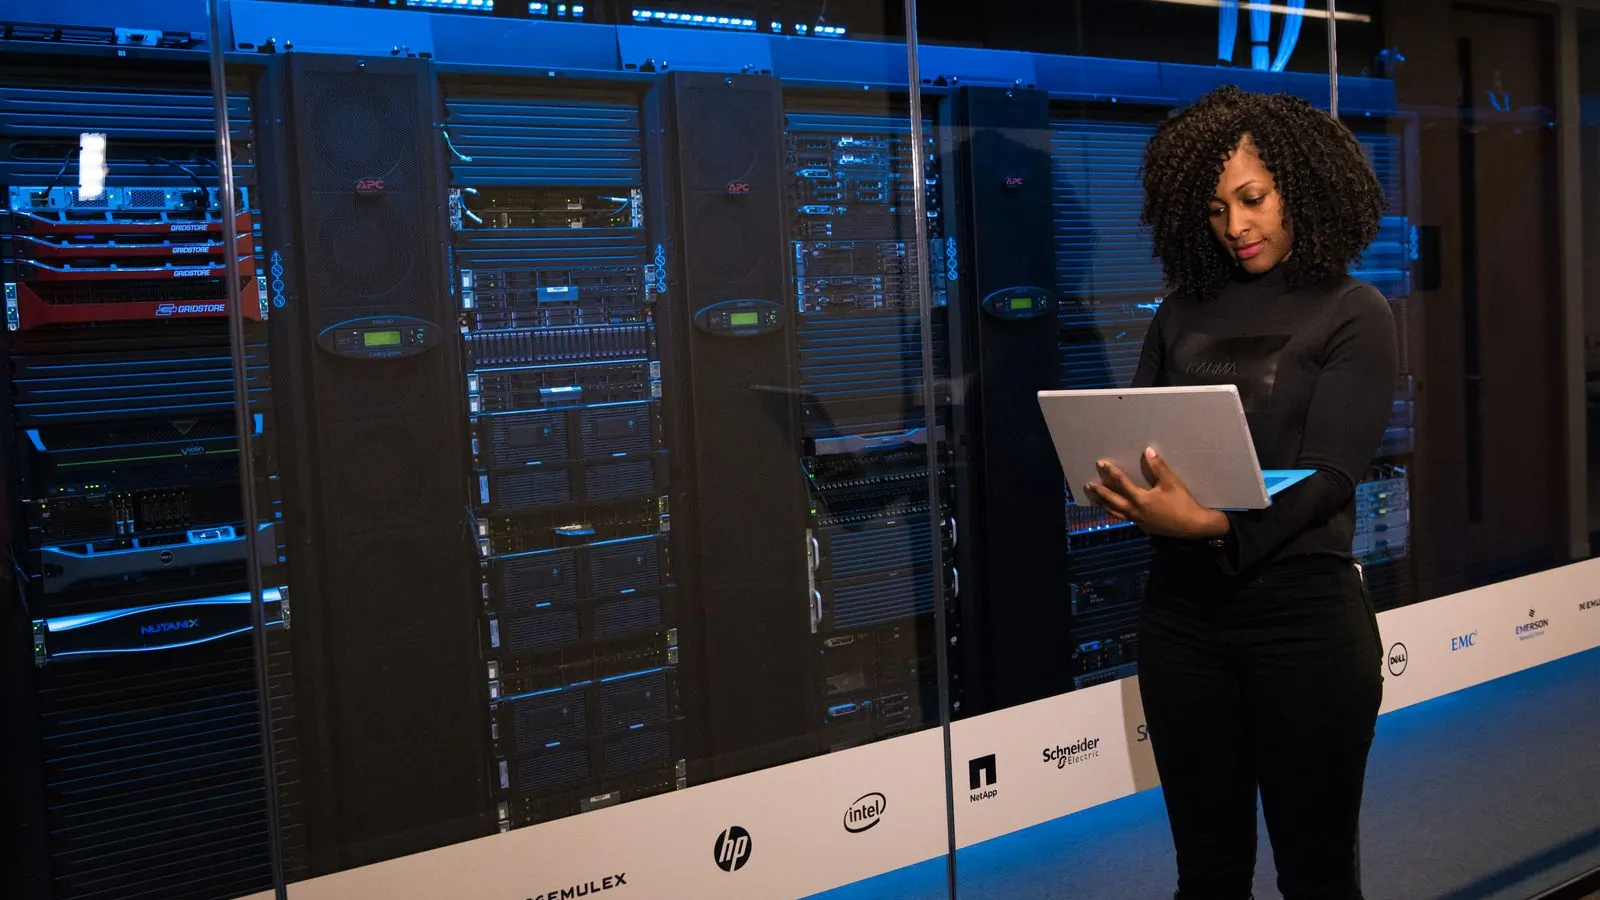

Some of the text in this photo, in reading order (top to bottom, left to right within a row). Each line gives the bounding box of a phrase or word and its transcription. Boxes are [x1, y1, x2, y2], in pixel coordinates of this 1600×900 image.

[356, 179, 385, 190] APC
[170, 224, 208, 232] GRIDSTORE
[172, 246, 210, 254] GRIDSTORE
[173, 269, 211, 277] GRIDSTORE
[178, 303, 225, 313] GRIDSTORE
[141, 618, 200, 636] NUTANIX
[1515, 618, 1549, 635] EMERSON
[1390, 653, 1406, 665] DELL
[1042, 737, 1100, 762] Schneider
[1067, 750, 1099, 765] Electric
[970, 789, 998, 803] NetApp
[849, 800, 879, 823] intel
[718, 826, 750, 872] hp
